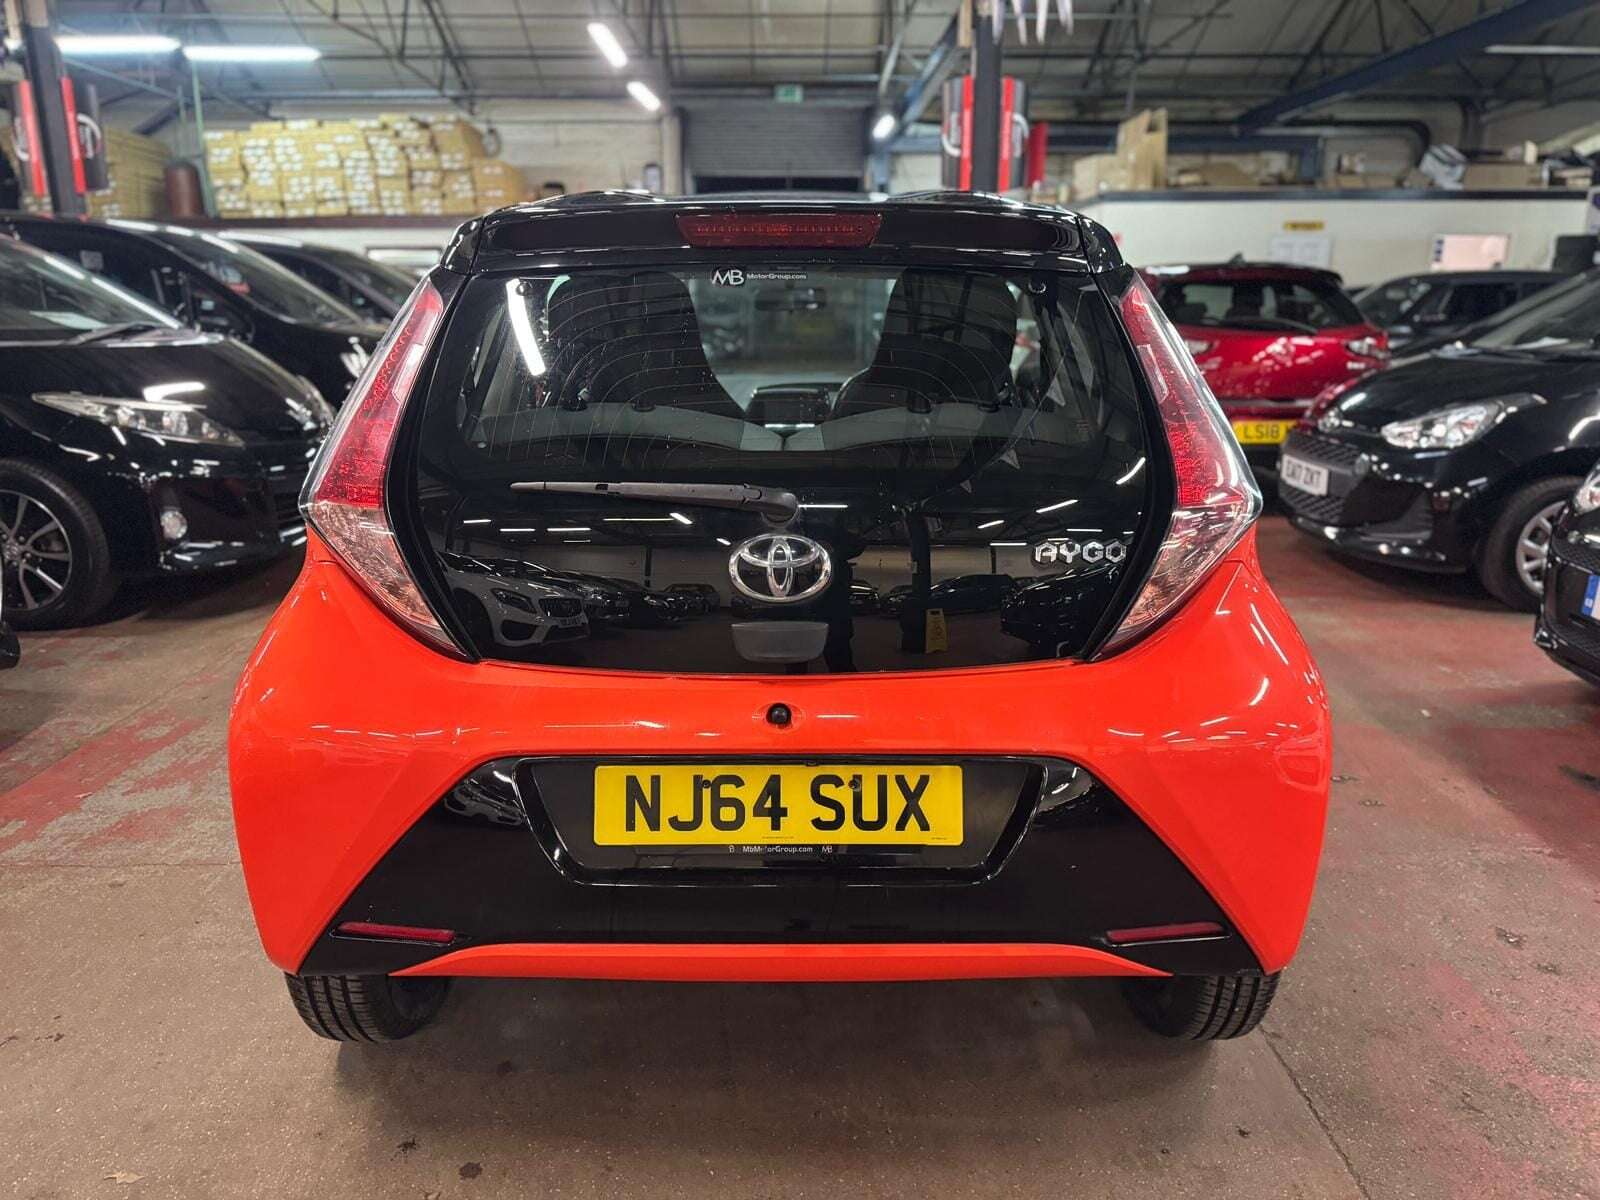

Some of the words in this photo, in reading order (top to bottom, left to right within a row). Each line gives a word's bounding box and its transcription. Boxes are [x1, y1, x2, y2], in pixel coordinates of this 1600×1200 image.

[711, 269, 745, 285] MB
[746, 272, 807, 280] MotorGroup.com
[1035, 541, 1127, 563] AYGO
[625, 774, 788, 831] NJ64
[810, 774, 930, 831] SUX
